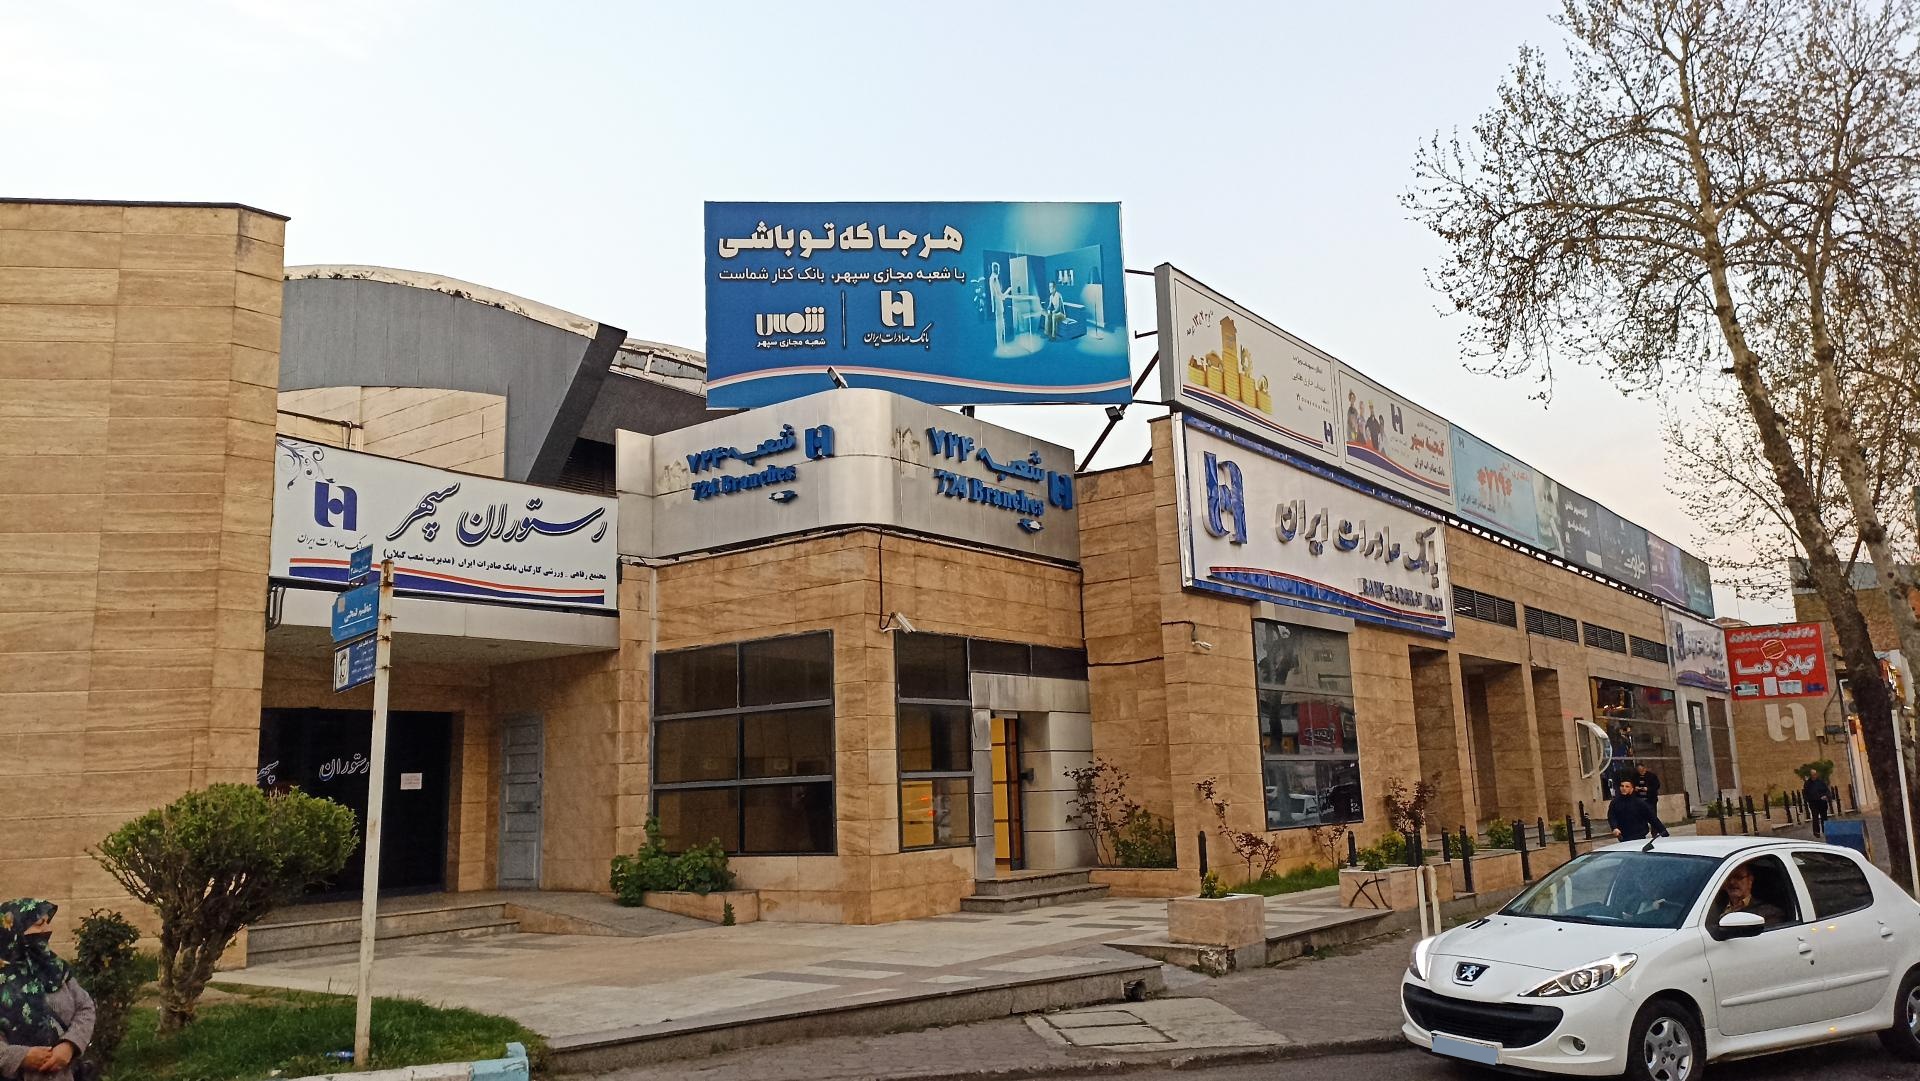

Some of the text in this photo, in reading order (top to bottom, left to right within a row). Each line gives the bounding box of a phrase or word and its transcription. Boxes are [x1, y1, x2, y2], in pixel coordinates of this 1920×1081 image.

[718, 220, 963, 259] هر جا که تو باشی
[718, 266, 966, 285] با شعبه مجازی سپهر، بانک کنار شماست
[756, 337, 826, 349] شعبه مجازی سپهر
[863, 323, 932, 349] بانک صادرات ایران
[726, 423, 797, 466] شعبه
[926, 427, 1045, 482] شعبه ۷۲۴
[691, 464, 797, 501] 724 Branches
[933, 468, 1044, 517] 724 Branches
[386, 482, 607, 546] رستوران سپهر
[1735, 659, 1773, 676] دما
[1775, 653, 1817, 677] گیلان
[318, 752, 369, 781] رستوران
